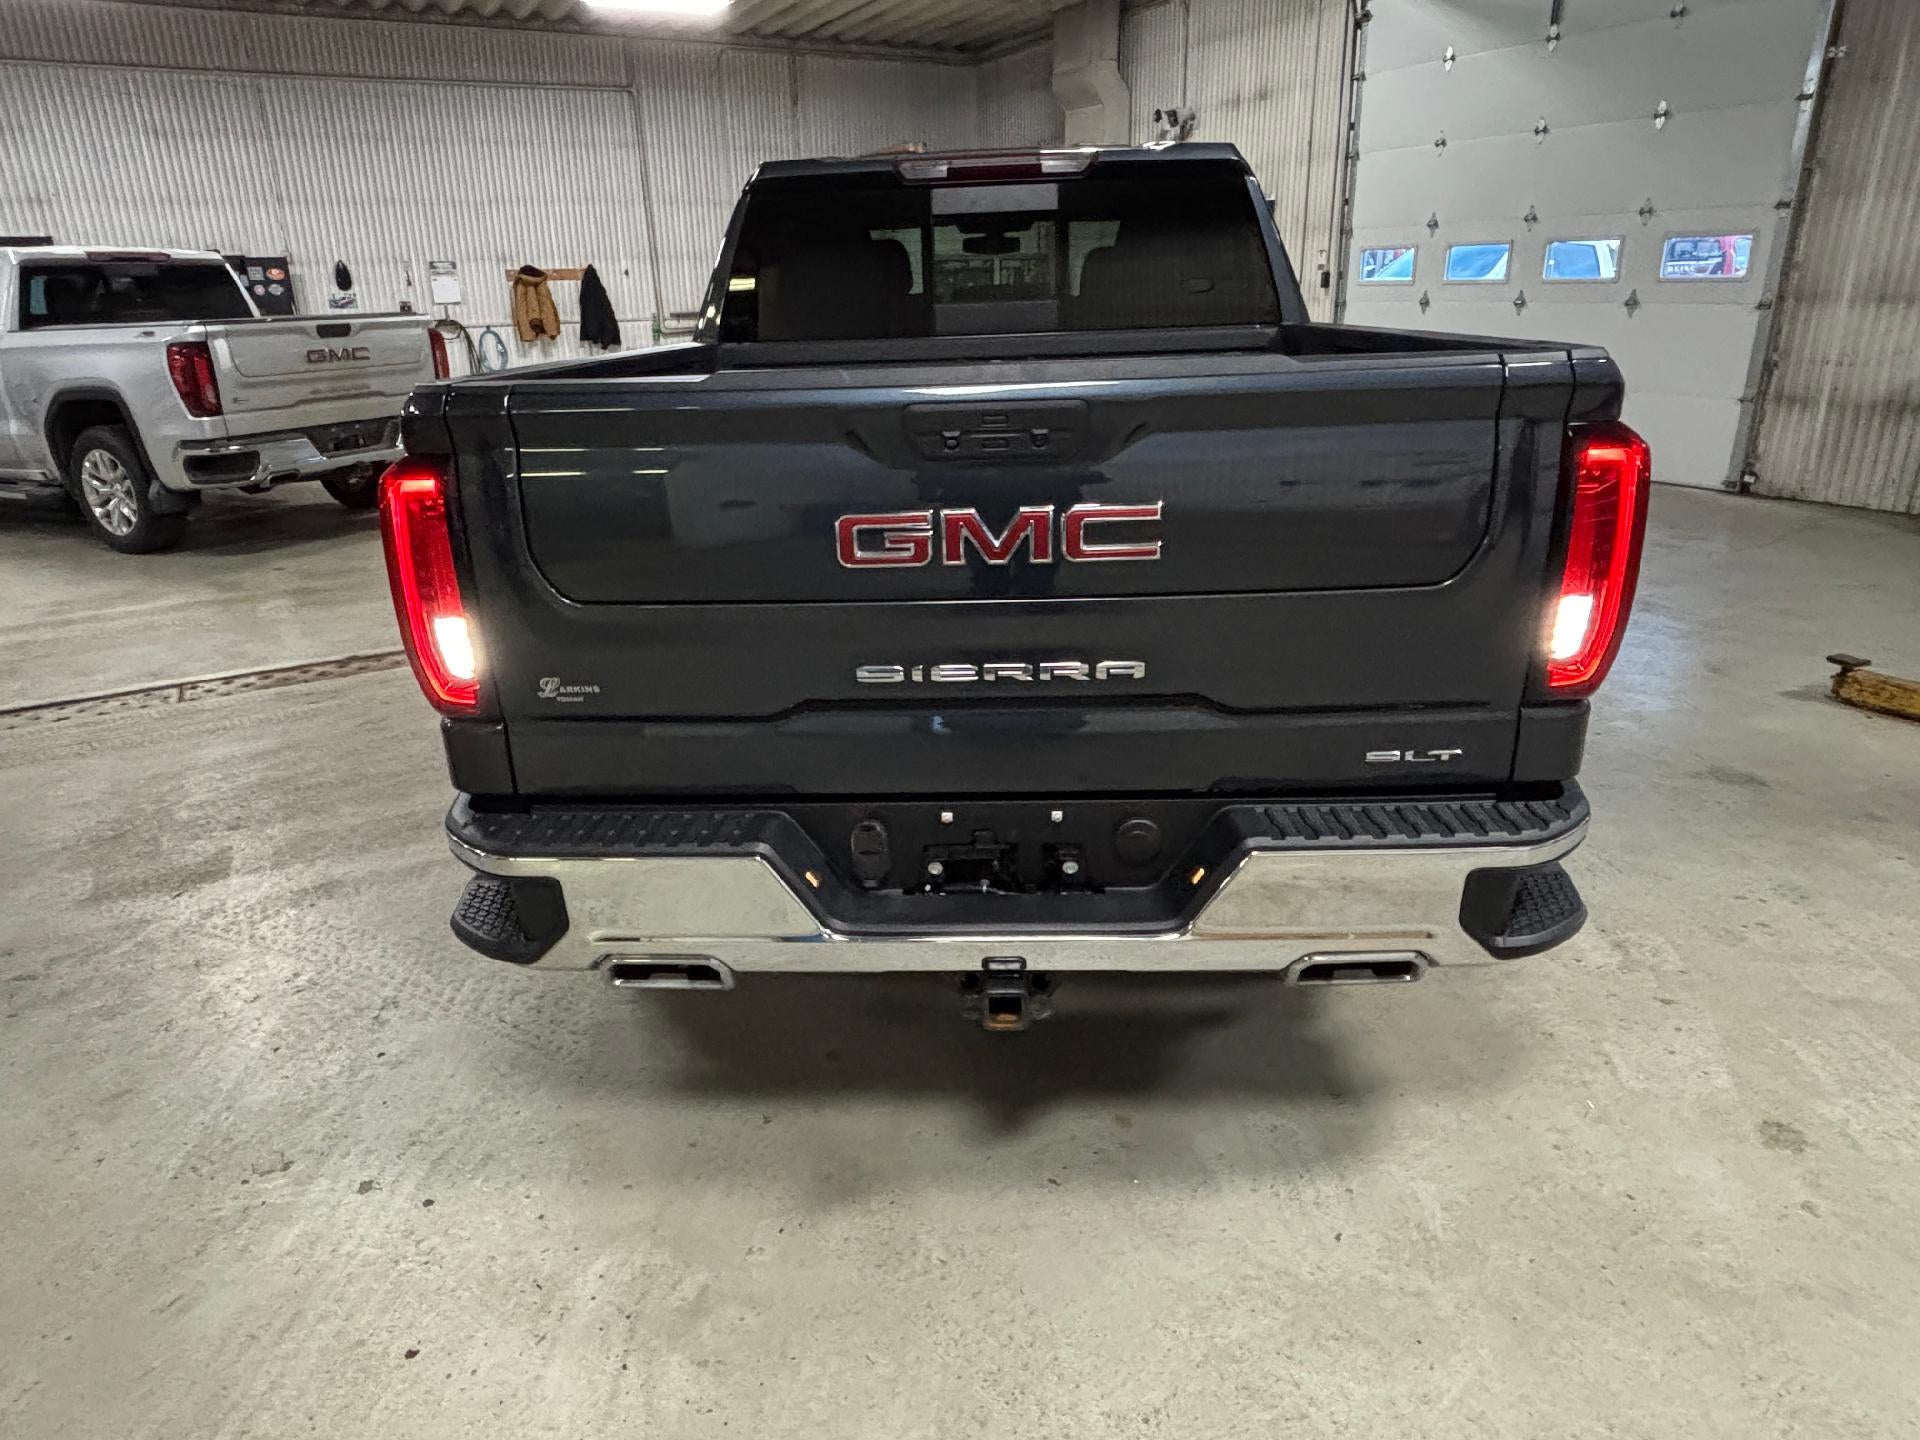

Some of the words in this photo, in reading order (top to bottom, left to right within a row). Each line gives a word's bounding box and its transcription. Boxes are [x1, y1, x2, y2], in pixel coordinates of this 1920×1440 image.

[306, 346, 371, 363] GMC
[835, 500, 1163, 568] GMC
[856, 660, 1146, 683] SIERRA
[1365, 749, 1463, 762] SLT
